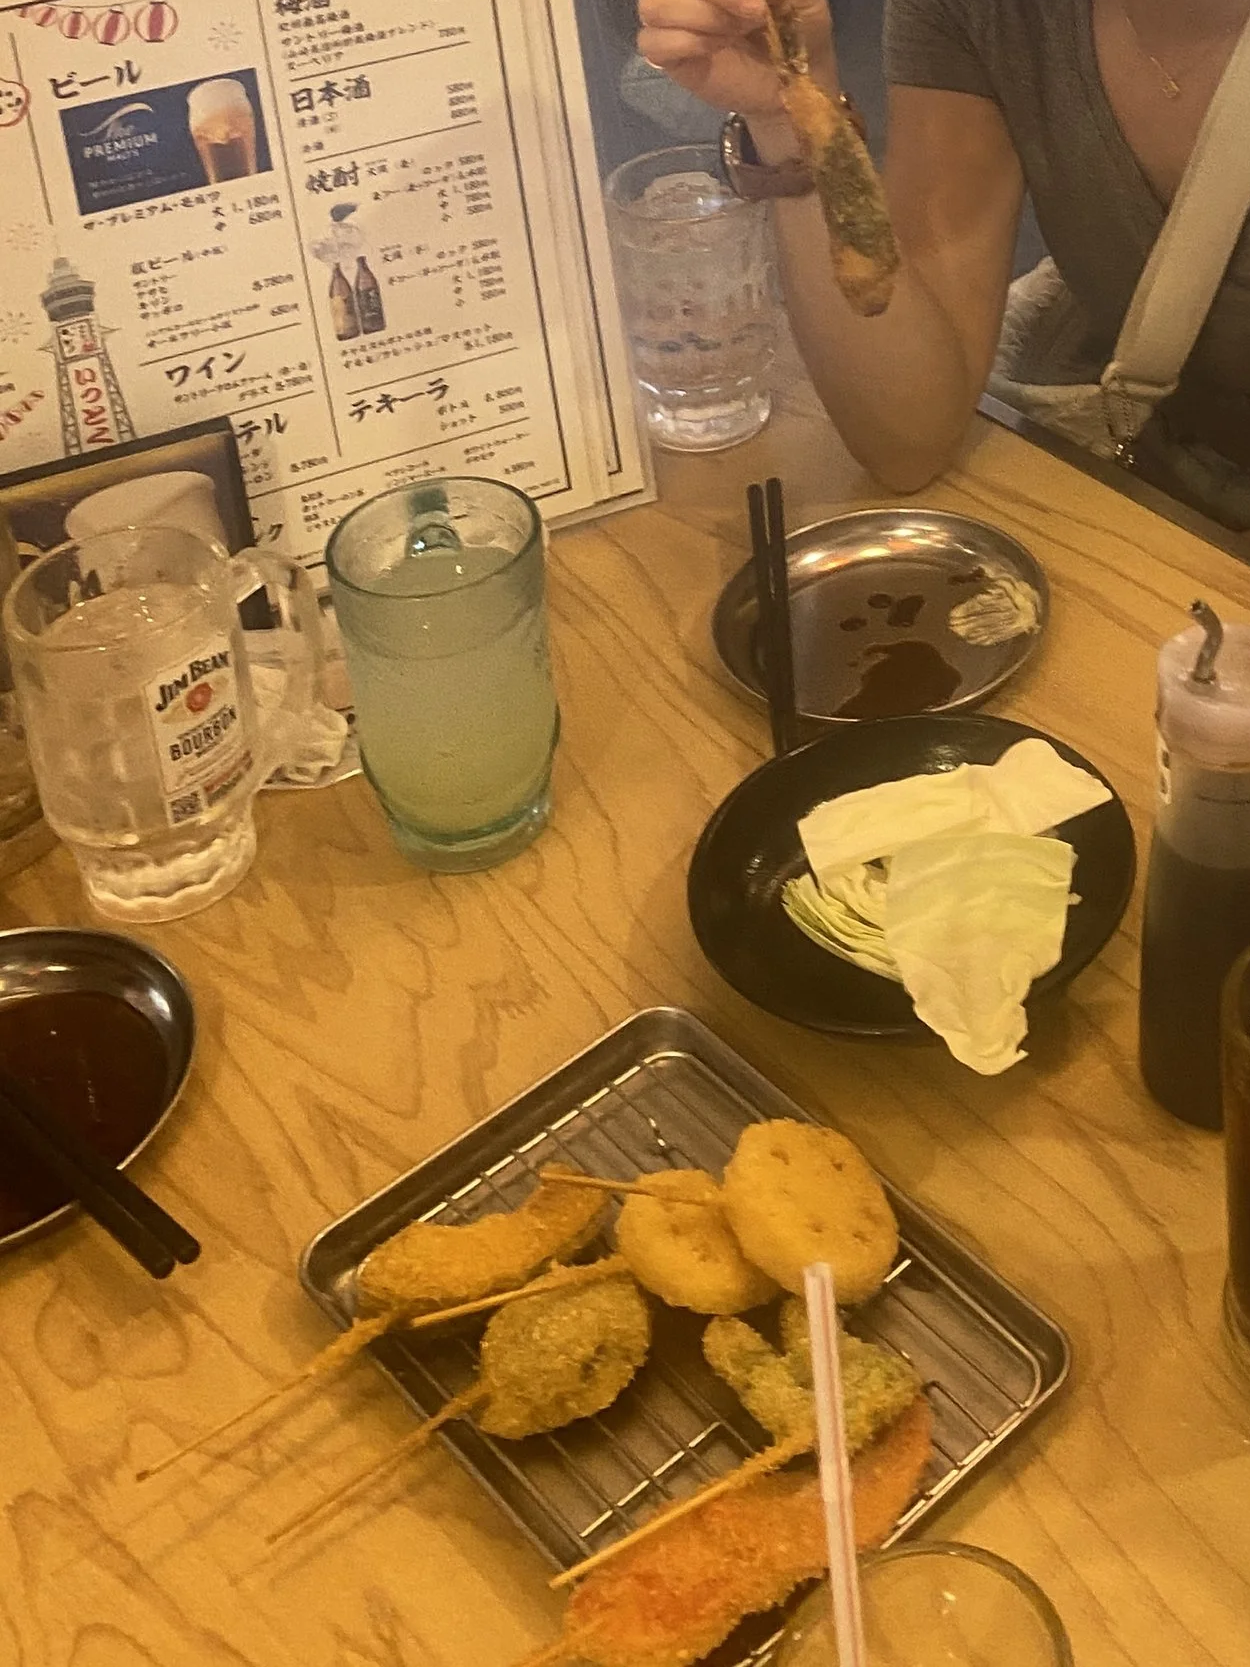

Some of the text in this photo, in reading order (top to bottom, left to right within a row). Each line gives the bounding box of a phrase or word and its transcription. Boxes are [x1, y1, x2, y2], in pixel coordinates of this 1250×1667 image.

[48, 60, 141, 99] ビール
[290, 74, 371, 113] 日本酒
[83, 131, 159, 160] PREMIUM
[305, 161, 360, 194] 焼酎
[165, 352, 245, 387] ワイン
[349, 378, 449, 422] テキーラ
